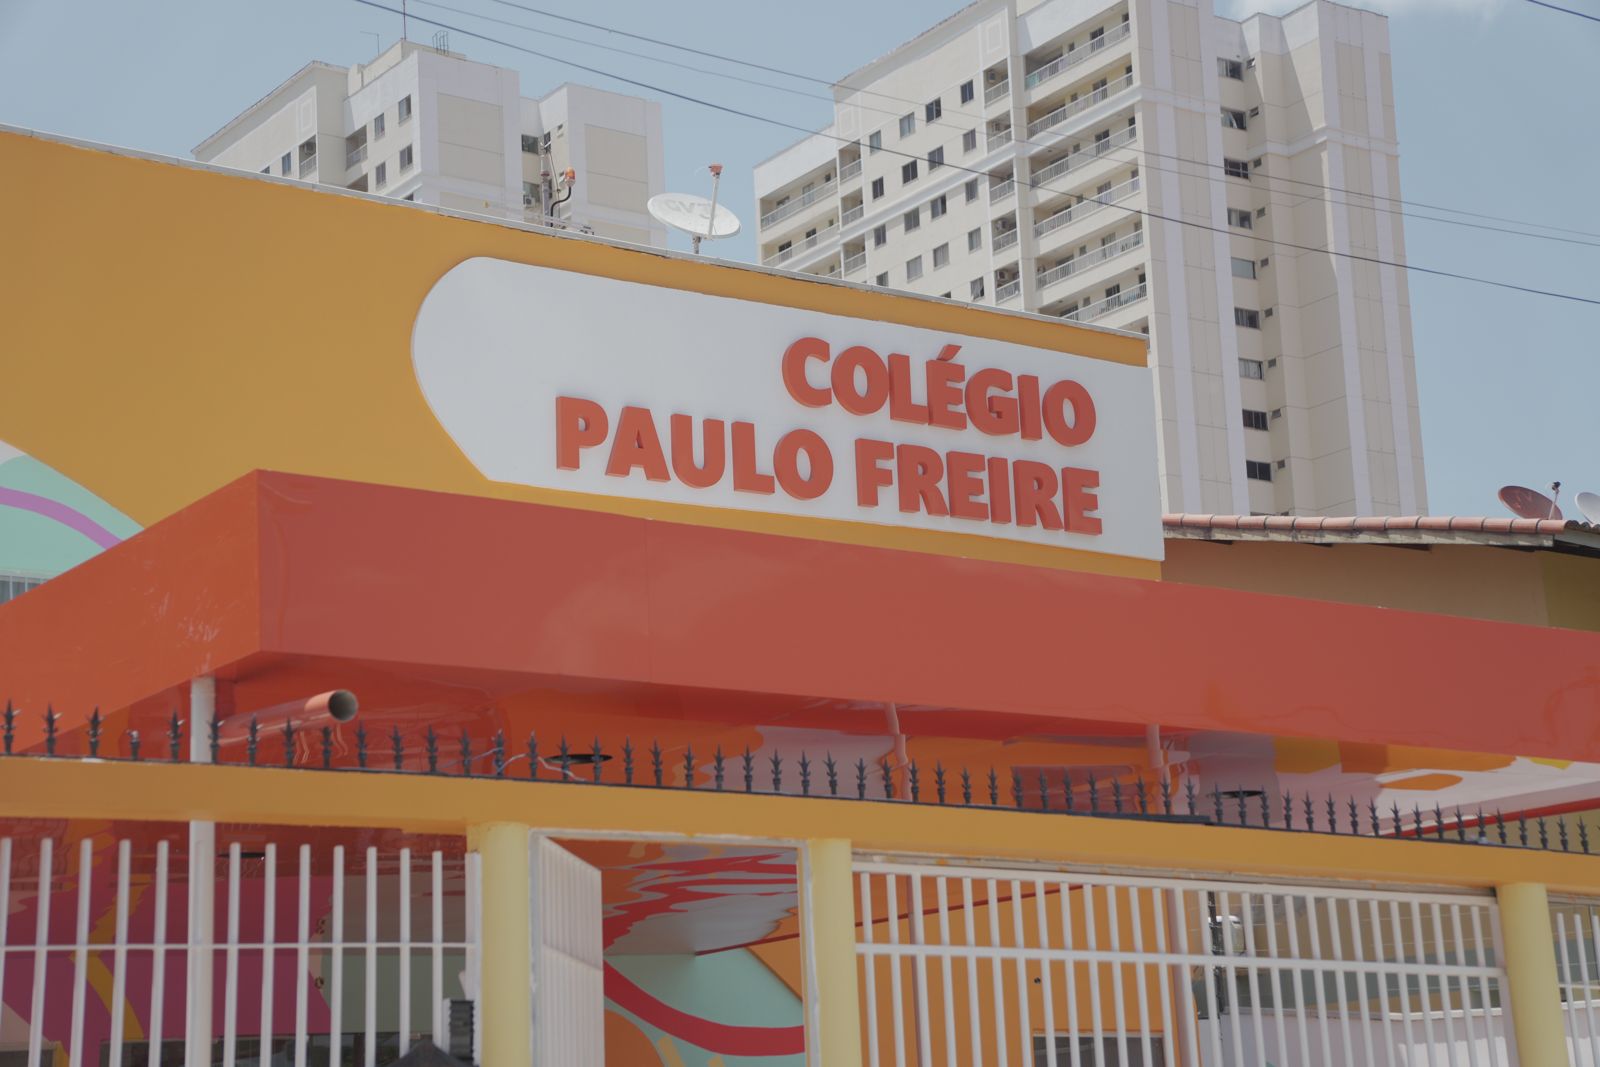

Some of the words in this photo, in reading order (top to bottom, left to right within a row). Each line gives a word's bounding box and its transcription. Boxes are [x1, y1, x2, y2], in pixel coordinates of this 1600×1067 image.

[782, 337, 1096, 447] COLÉGIO
[556, 396, 834, 500] PAULO
[854, 438, 1103, 536] FREIRE
